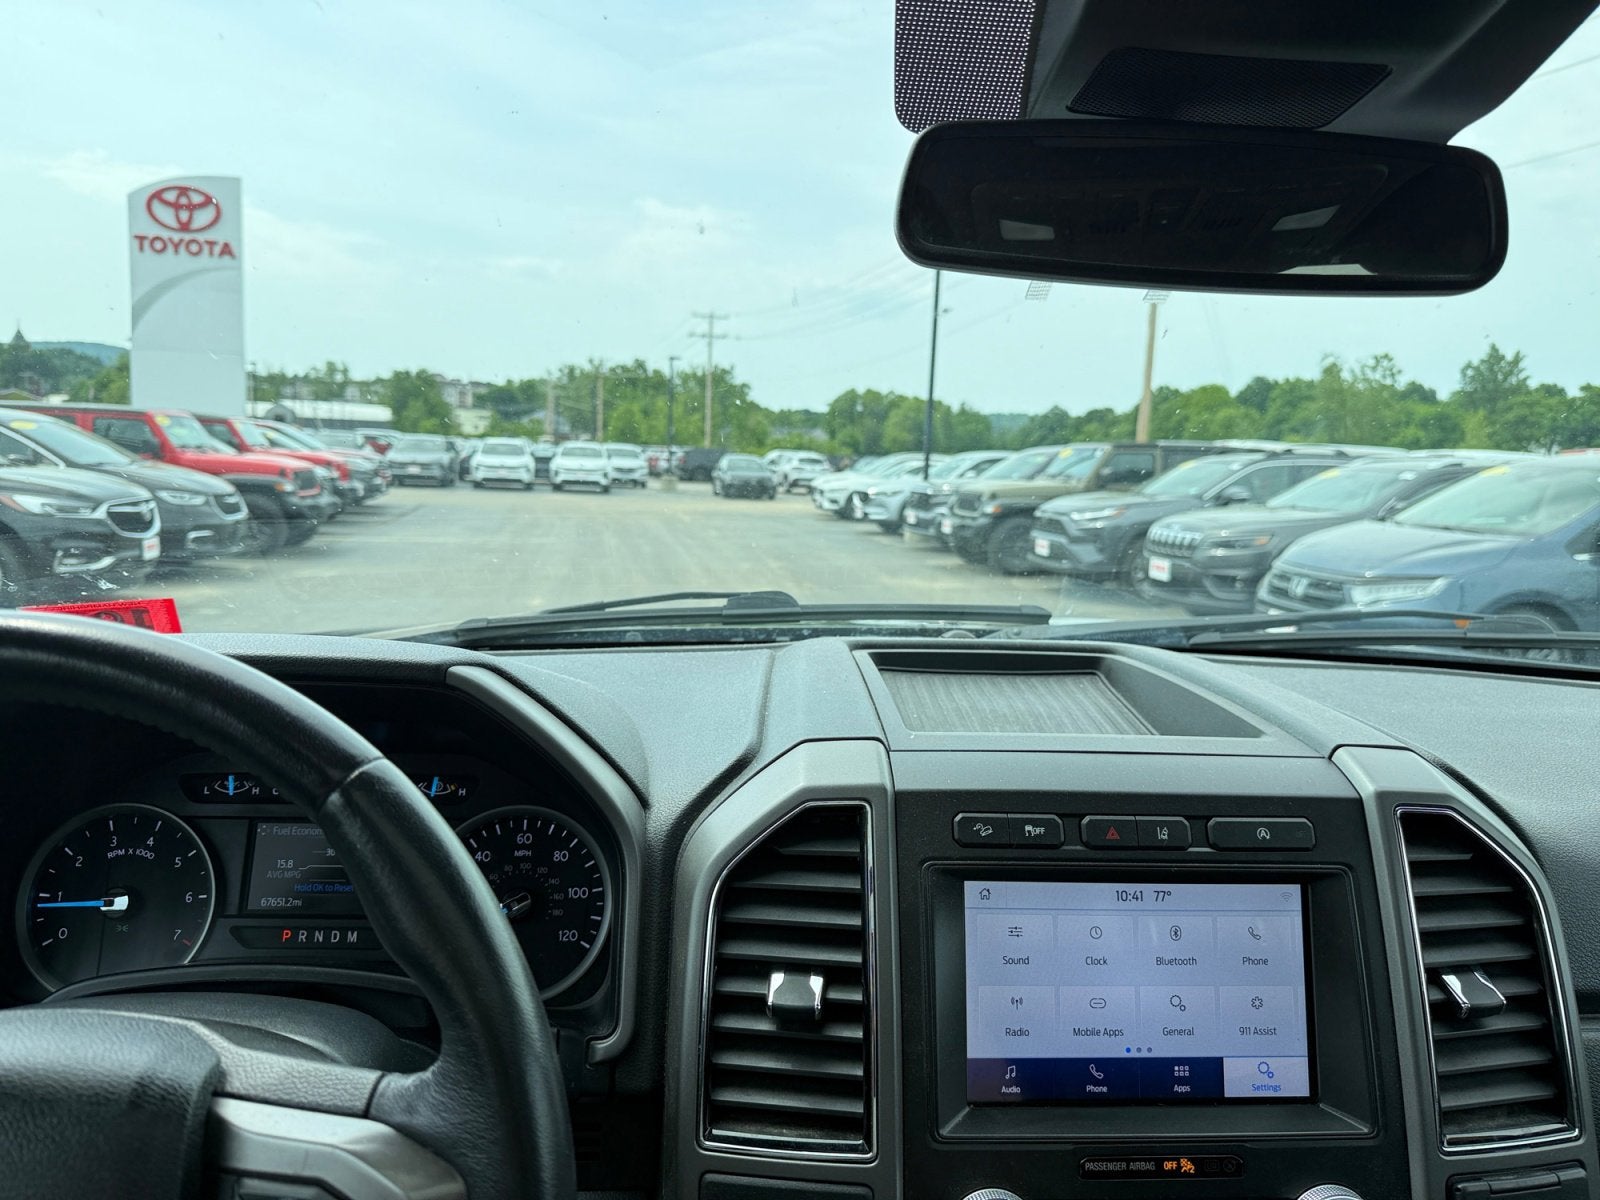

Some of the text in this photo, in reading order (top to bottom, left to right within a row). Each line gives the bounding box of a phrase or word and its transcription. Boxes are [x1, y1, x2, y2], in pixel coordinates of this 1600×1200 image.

[133, 235, 236, 259] TOYOTA
[204, 786, 210, 794] L
[252, 786, 259, 795] H
[458, 788, 466, 796] H
[272, 826, 322, 836] Fuel Econom
[1032, 827, 1045, 835] OFF
[110, 836, 117, 846] 3
[147, 836, 154, 846] 4
[516, 833, 533, 844] 60
[107, 848, 125, 860] RPM
[136, 848, 155, 860] 1000
[475, 851, 491, 862] 40
[553, 851, 569, 862] 80
[75, 856, 83, 867] 2
[174, 856, 182, 868] 5
[277, 860, 294, 868] 15.8
[267, 871, 302, 879] AVG MPG
[294, 883, 311, 892] Hold
[312, 883, 324, 892] OK
[325, 884, 333, 892] to
[568, 887, 589, 898] 100
[57, 891, 62, 901] 1
[185, 891, 193, 902] 6
[1115, 890, 1144, 902] 10:41
[59, 927, 68, 939] 0
[173, 929, 181, 940] 7
[282, 930, 358, 942] P R N D M
[559, 930, 578, 941] 120
[1002, 955, 1030, 965] Sound
[1085, 955, 1108, 966] Clock
[1156, 956, 1197, 966] Bluetooth
[1242, 956, 1269, 966] Phone
[1005, 1027, 1030, 1037] Radio
[1073, 1027, 1124, 1040] Mobile Apps
[1162, 1027, 1194, 1037] General
[1239, 1026, 1277, 1036] 911 Assist
[1001, 1085, 1021, 1094] Audio
[1086, 1084, 1108, 1093] Phone
[1173, 1084, 1190, 1094] Apps
[1251, 1083, 1282, 1094] Settings
[1085, 1162, 1127, 1171] PASSENGER
[1129, 1162, 1156, 1171] AIRBAG
[1163, 1161, 1178, 1170] OFF
